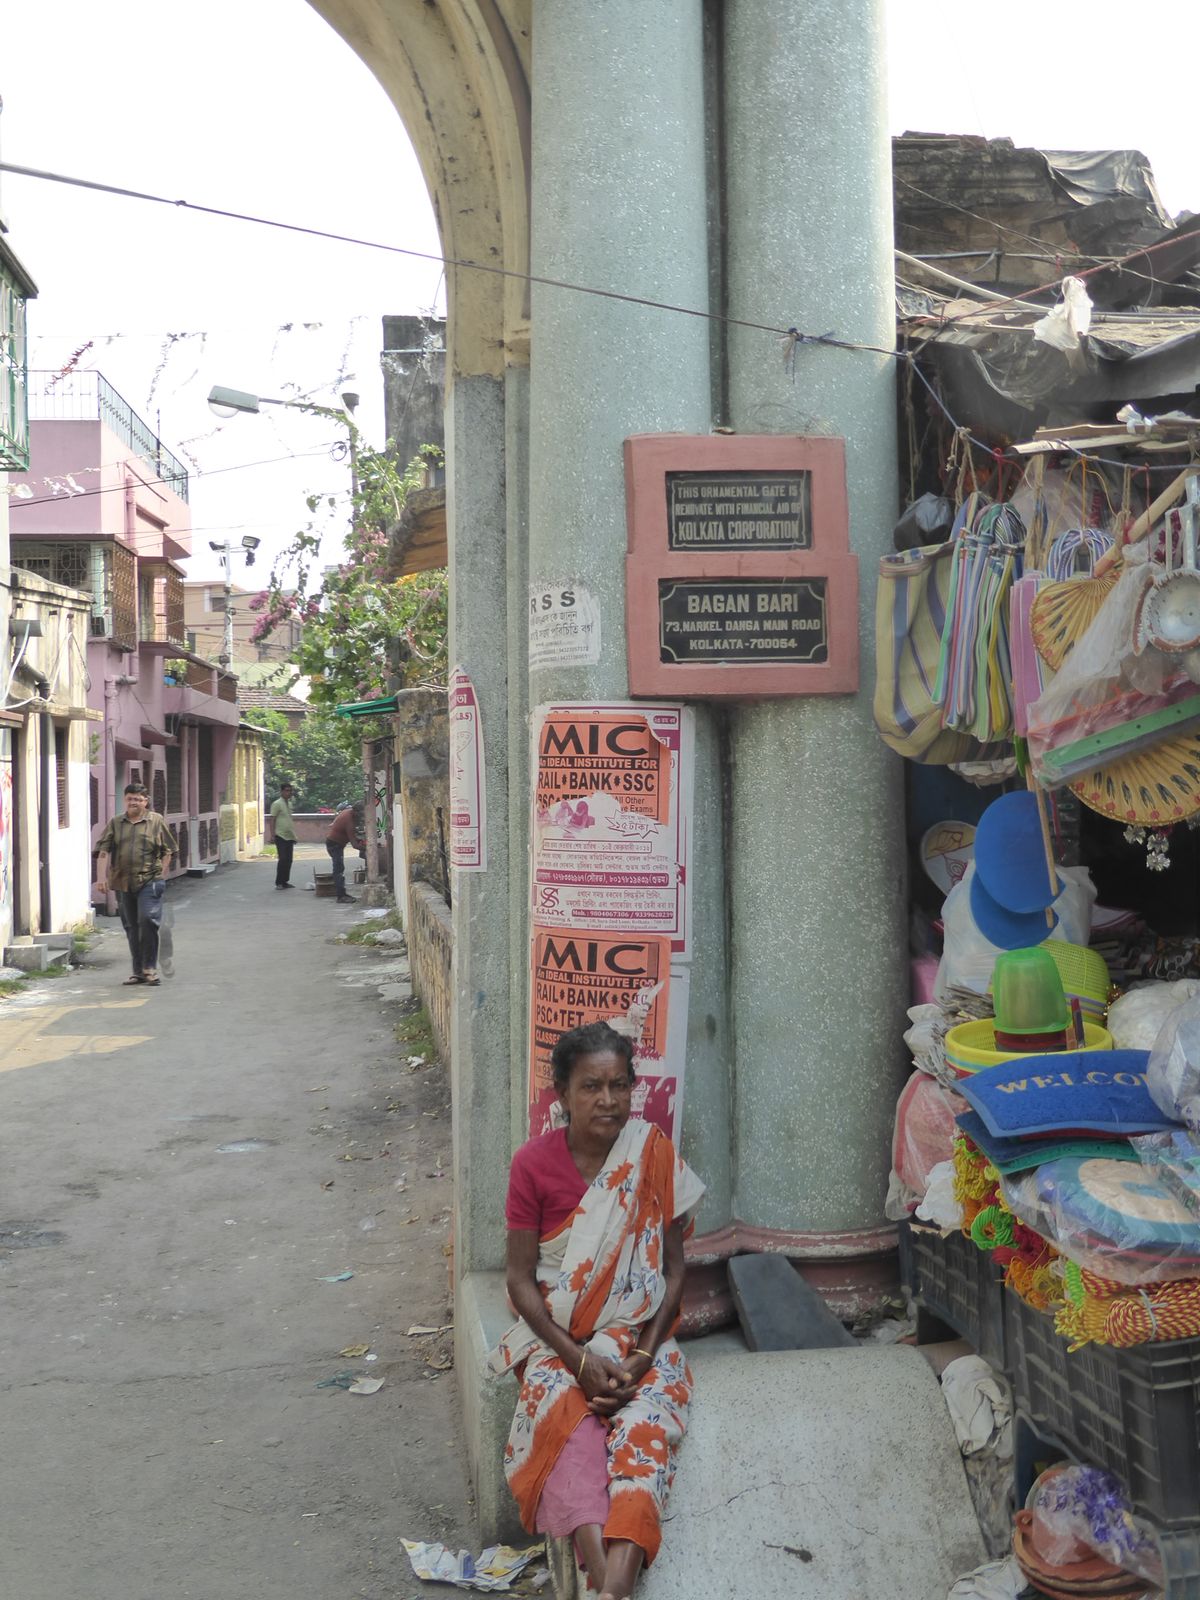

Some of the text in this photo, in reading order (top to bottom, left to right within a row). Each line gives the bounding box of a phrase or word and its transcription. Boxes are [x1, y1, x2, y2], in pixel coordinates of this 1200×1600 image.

[677, 484, 798, 498] THIS ORNAMENTAL GATE IS
[715, 503, 735, 515] WITH
[736, 502, 775, 515] FINANCIAL
[776, 502, 790, 514] AID
[791, 502, 801, 514] OF
[678, 519, 800, 541] KOLKATA CORPORATION
[687, 593, 799, 613] BAGAN BARI
[725, 619, 760, 632] DANGA
[762, 619, 789, 631] MAIN
[791, 618, 821, 631] ROAD
[543, 724, 648, 756] MIC
[547, 758, 572, 767] IDEAL
[574, 758, 632, 769] INSTITUTE
[634, 759, 658, 769] FOR
[538, 772, 655, 791] RAIL BANK SSC
[625, 796, 645, 805] Other
[630, 805, 654, 813] Exams
[541, 938, 646, 975] MIC
[545, 970, 570, 983] IDEAL
[572, 973, 630, 988] INSTITUTE
[537, 982, 558, 1003] RAIL
[567, 987, 610, 1009] BANK
[536, 1004, 585, 1028] PSC TET
